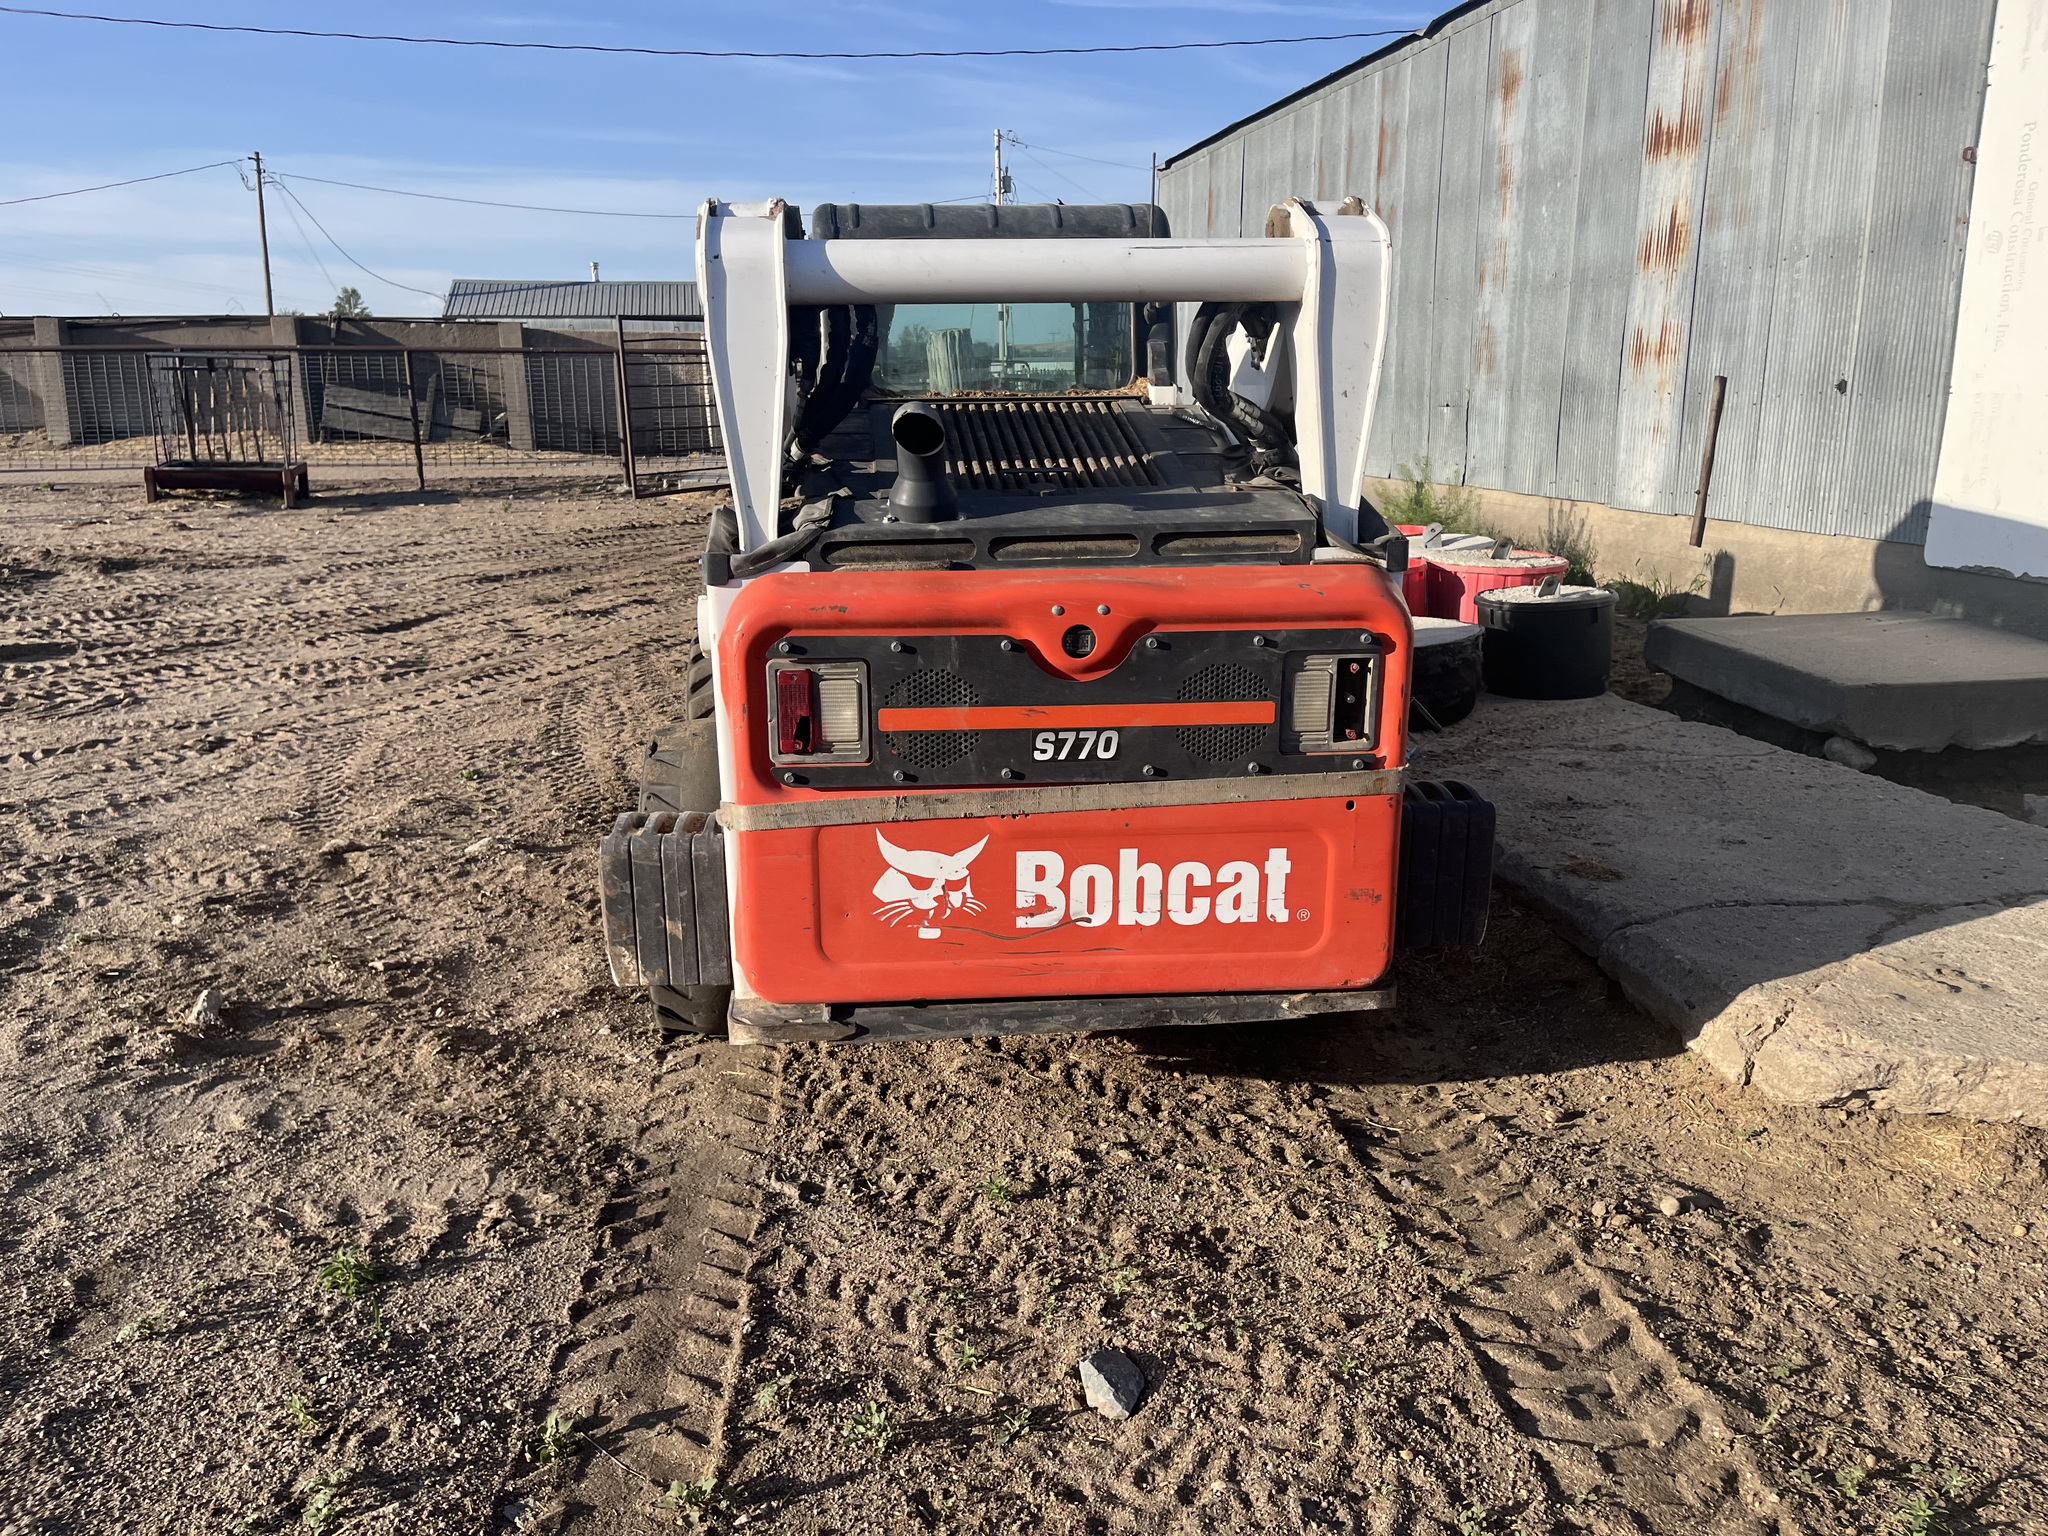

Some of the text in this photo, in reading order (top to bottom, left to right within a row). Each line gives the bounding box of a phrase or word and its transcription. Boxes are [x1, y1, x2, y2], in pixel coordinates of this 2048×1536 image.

[2013, 120, 2038, 206] Ponderosa
[2025, 181, 2039, 224] General
[1997, 211, 2025, 318] Construction,
[1033, 730, 1119, 761] S770
[1015, 848, 1292, 928] Bobcat
